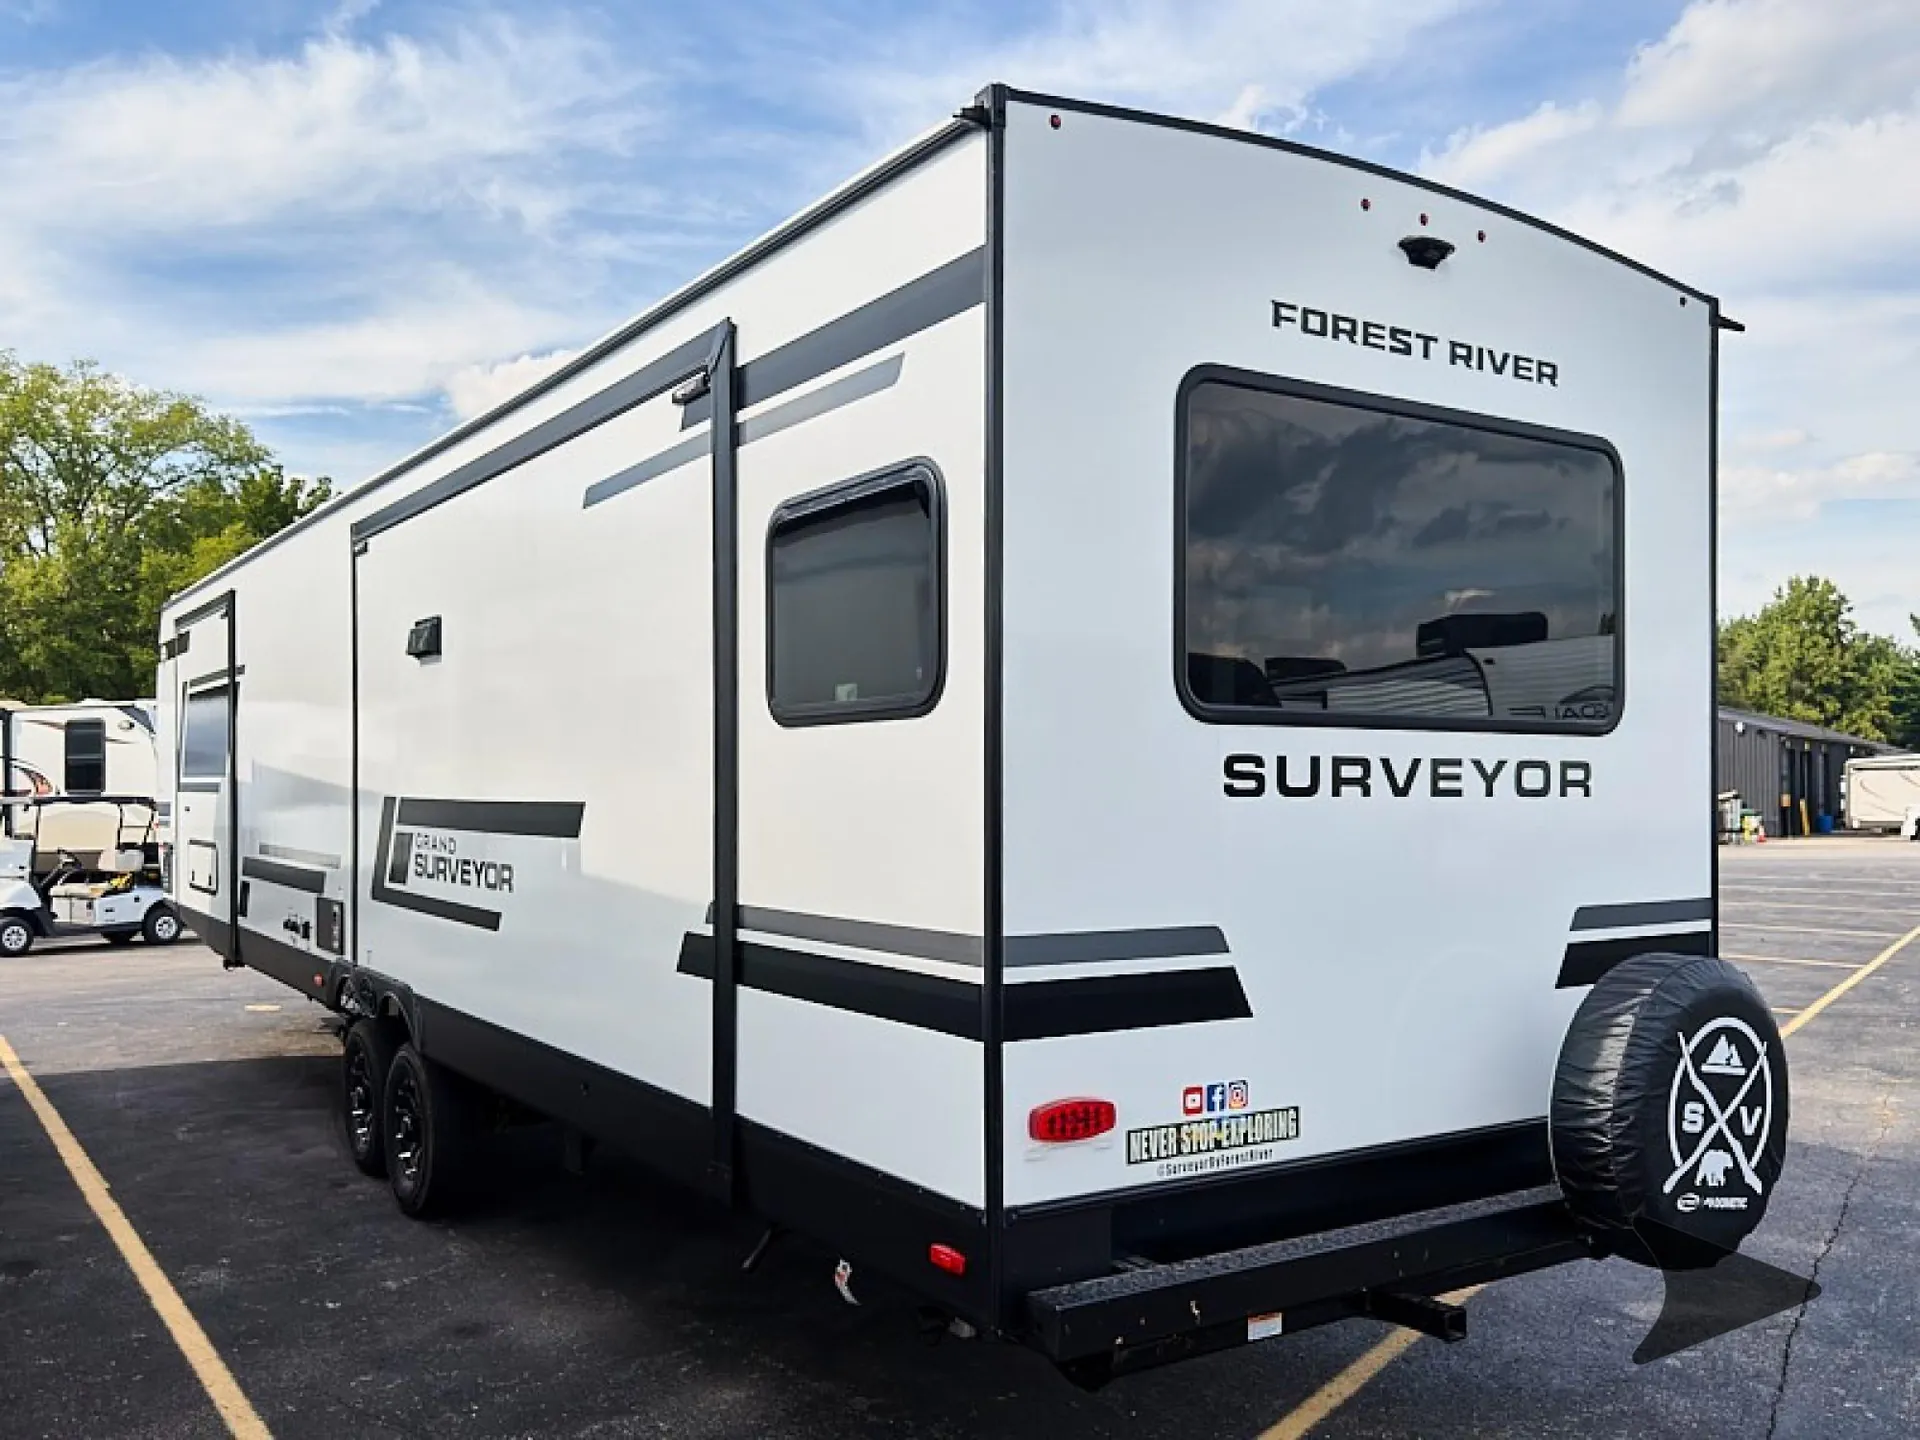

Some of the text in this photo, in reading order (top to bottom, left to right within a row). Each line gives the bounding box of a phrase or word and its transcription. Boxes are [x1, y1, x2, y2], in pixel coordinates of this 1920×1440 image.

[1270, 300, 1559, 387] FOREST RIVER
[1223, 753, 1593, 798] SURVEYOR
[415, 832, 457, 855] GRAND
[414, 853, 514, 893] SURVEYOR
[1130, 1107, 1298, 1164] NEVER STOP EXPLORING
